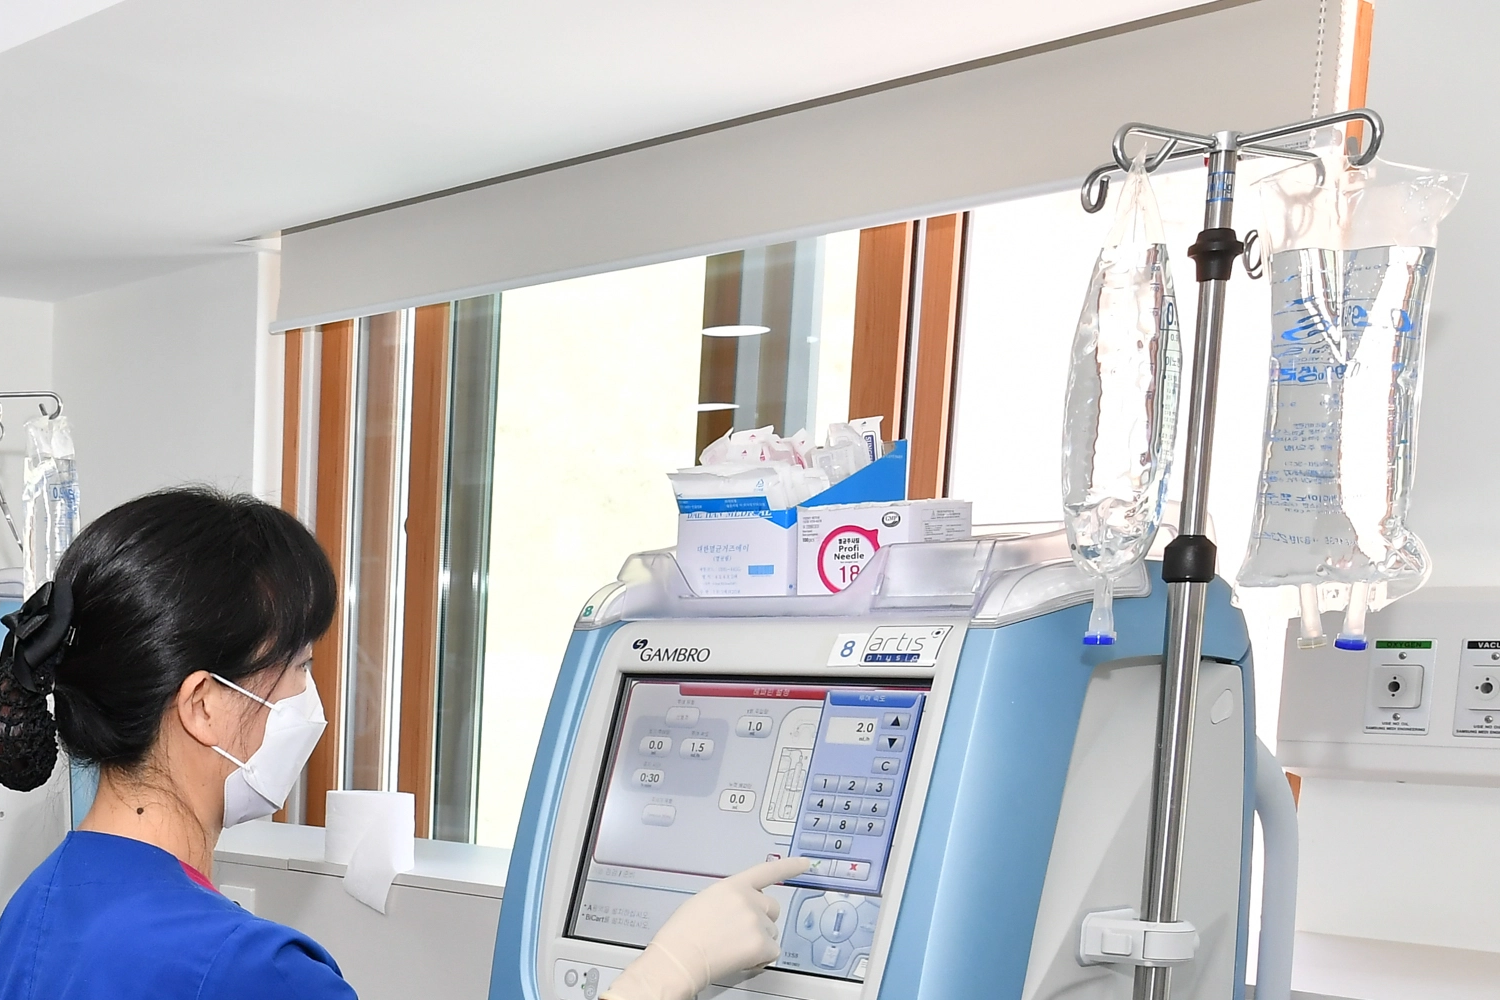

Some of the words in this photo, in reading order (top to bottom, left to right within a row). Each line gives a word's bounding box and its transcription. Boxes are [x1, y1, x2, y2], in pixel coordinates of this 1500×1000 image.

[839, 544, 860, 552] Profi
[834, 552, 865, 560] Needle
[583, 605, 594, 617] 8
[869, 633, 927, 651] artis
[840, 640, 856, 658] 8
[640, 648, 711, 663] GAMBRO
[748, 721, 763, 731] 1.0
[856, 722, 874, 733] 2.0
[649, 740, 664, 750] 0.0
[691, 742, 705, 753] 1.5
[881, 761, 891, 772] C
[640, 773, 660, 783] 0:30
[822, 778, 828, 789] 1
[847, 781, 856, 791] 2
[875, 782, 883, 793] 3
[729, 794, 745, 804] 0.0
[816, 798, 824, 808] 4
[843, 801, 851, 811] 5
[871, 802, 878, 813] 6
[813, 818, 820, 827] 7
[839, 820, 847, 830] 8
[867, 822, 874, 832] 9
[834, 839, 842, 850] 0
